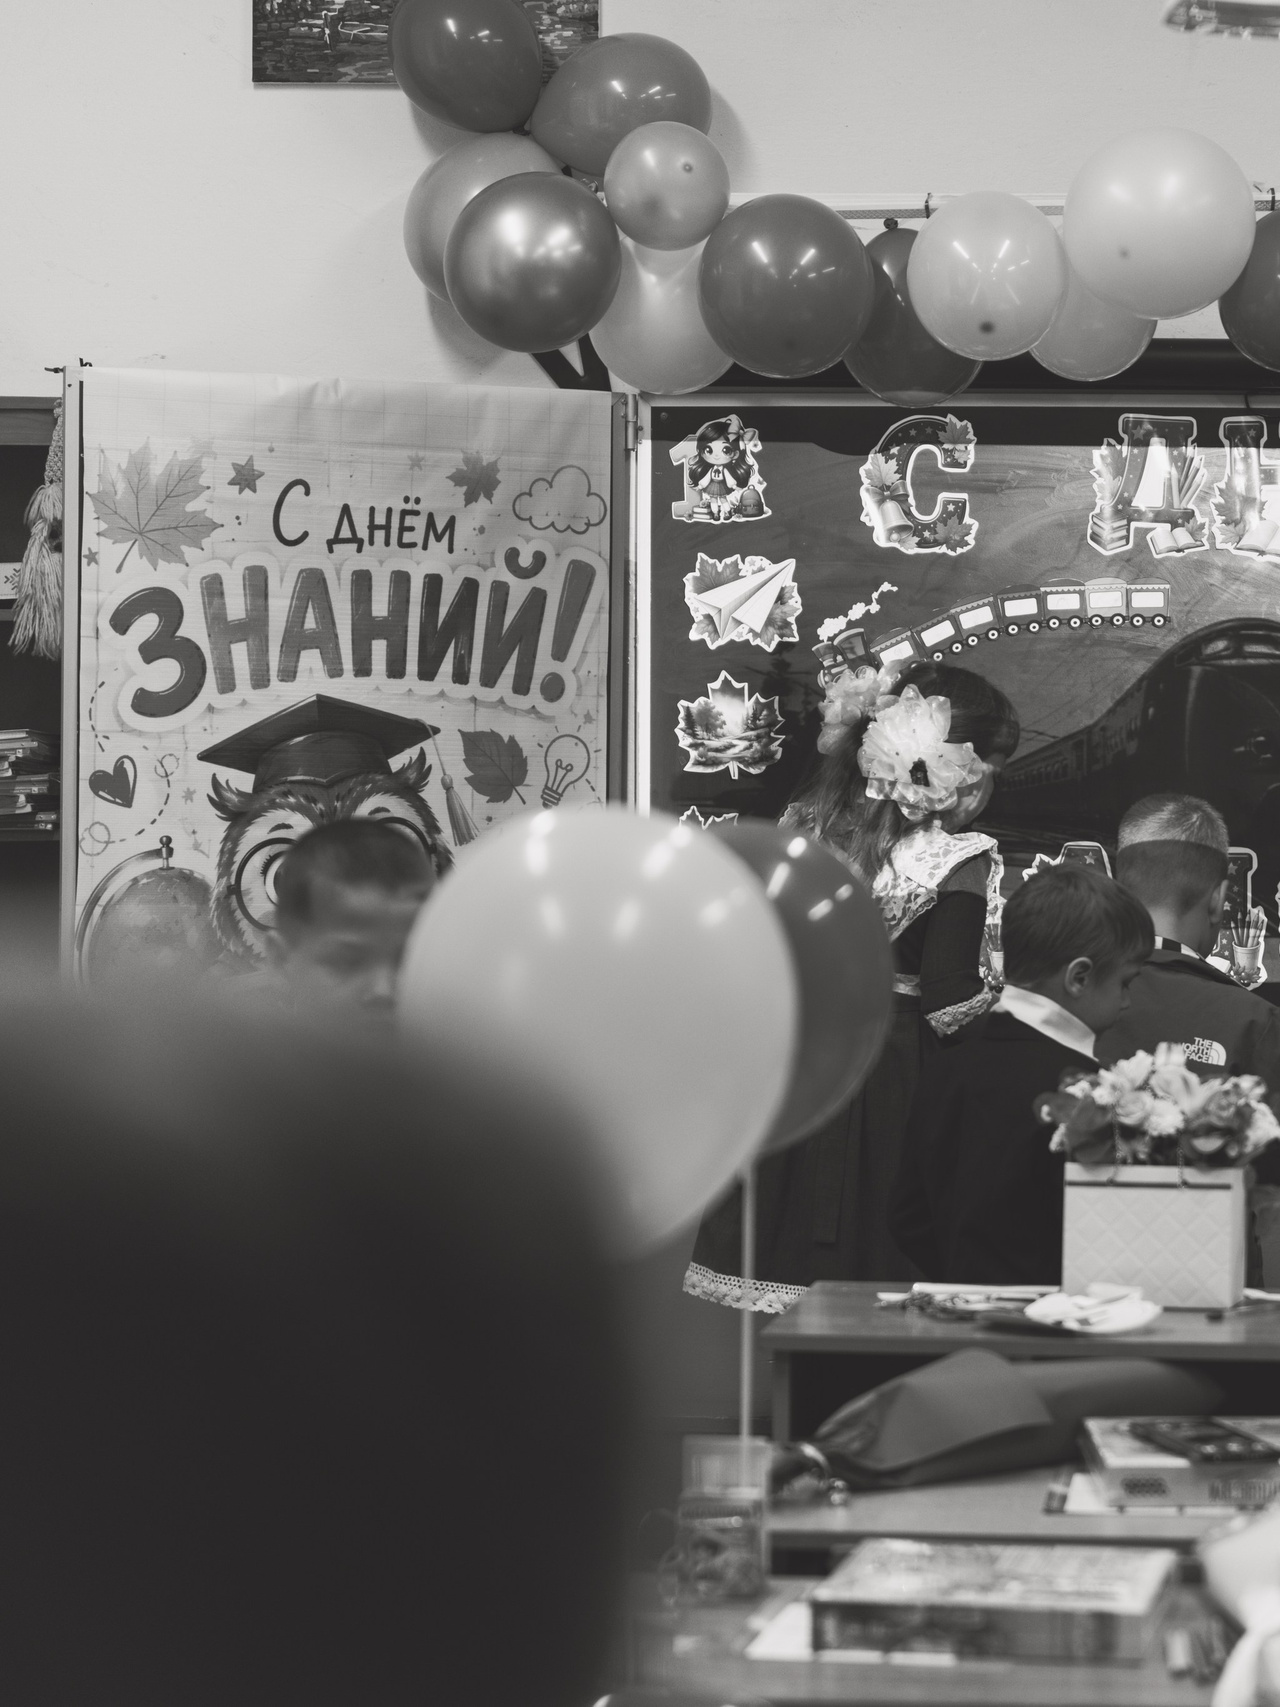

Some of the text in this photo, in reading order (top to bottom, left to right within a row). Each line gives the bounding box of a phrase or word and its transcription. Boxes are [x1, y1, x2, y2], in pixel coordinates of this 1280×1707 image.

[273, 478, 456, 554] С ДНЁМ
[861, 414, 979, 556] С
[109, 547, 596, 718] ЗНАНИЙ!
[1184, 1051, 1210, 1063] FACE
[1194, 1036, 1213, 1048] THE
